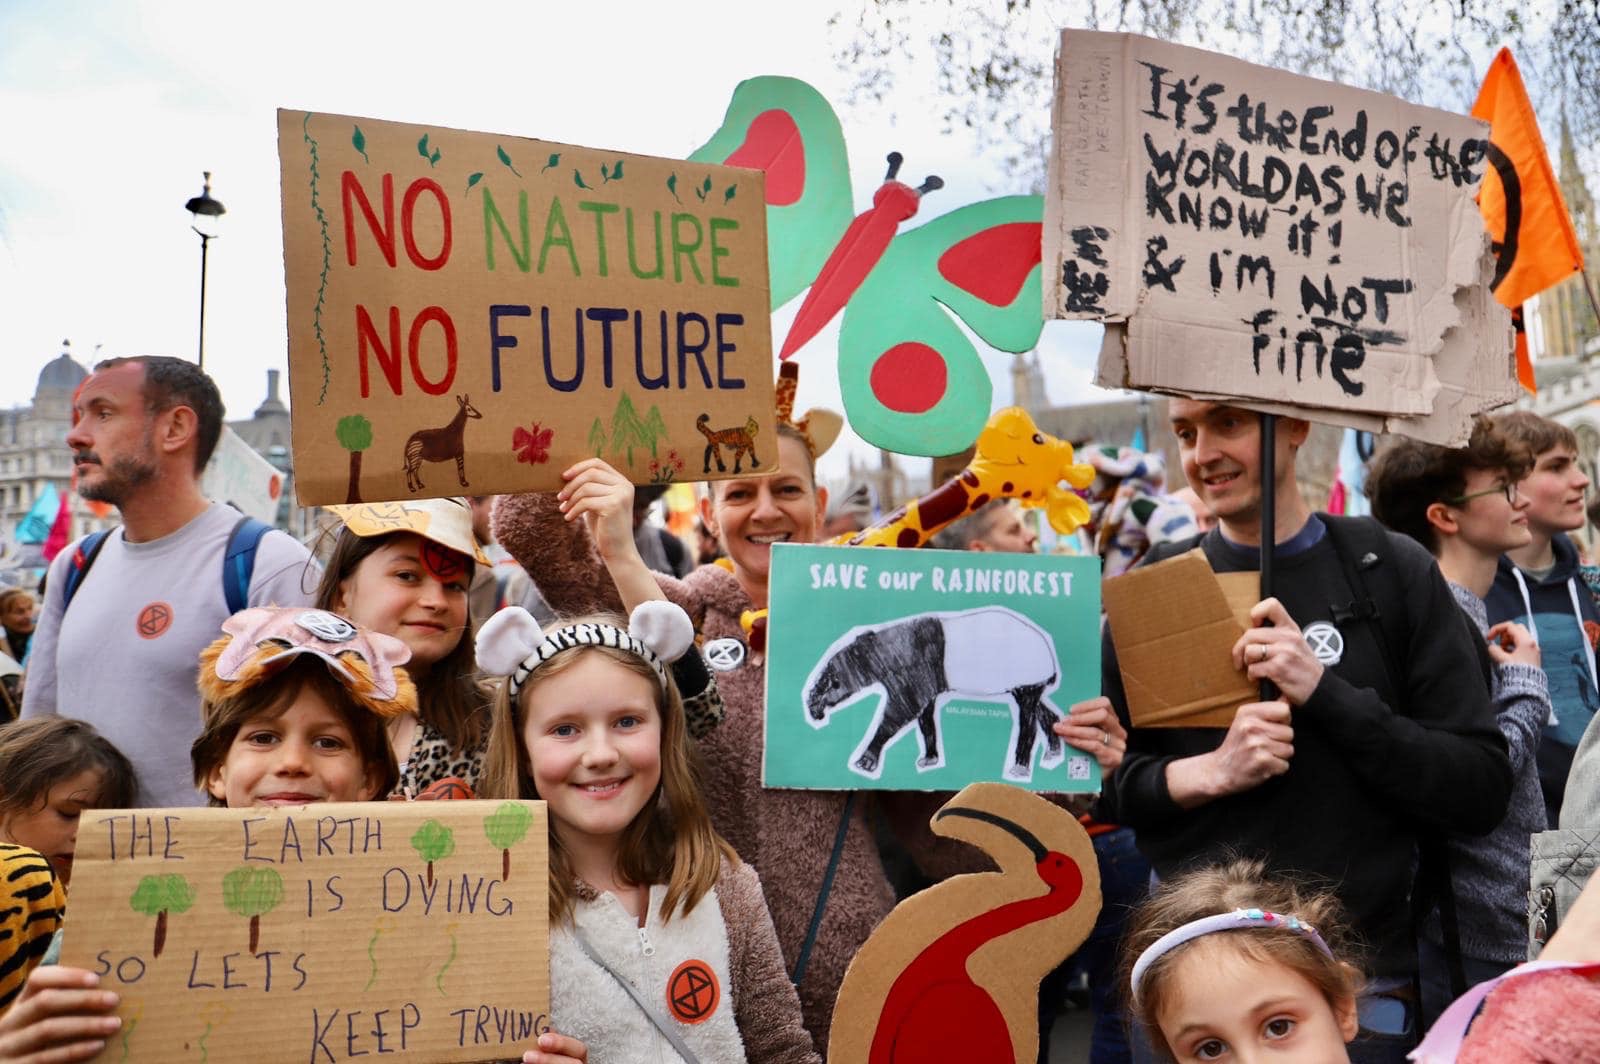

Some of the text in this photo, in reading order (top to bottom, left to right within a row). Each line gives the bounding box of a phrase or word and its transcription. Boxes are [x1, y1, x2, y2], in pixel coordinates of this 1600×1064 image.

[1136, 60, 1226, 134] It's
[1227, 93, 1298, 153] the
[1300, 105, 1368, 163] End
[1425, 133, 1487, 187] the
[1143, 132, 1292, 204] WORLD
[1295, 162, 1346, 216] AS
[1145, 170, 1269, 239] KNOW
[341, 169, 741, 288] NO NATURE
[1062, 224, 1111, 315] REM
[1142, 235, 1186, 292] &
[355, 303, 746, 399] NO FUTURE
[1241, 308, 1367, 397] fine
[809, 563, 1074, 597] SAVE our RAINFOREST
[99, 814, 383, 864] THE EARTH
[307, 866, 514, 918] IS DYING
[94, 949, 308, 993] SO LETS
[309, 1002, 550, 1064] KEEP TRYING
